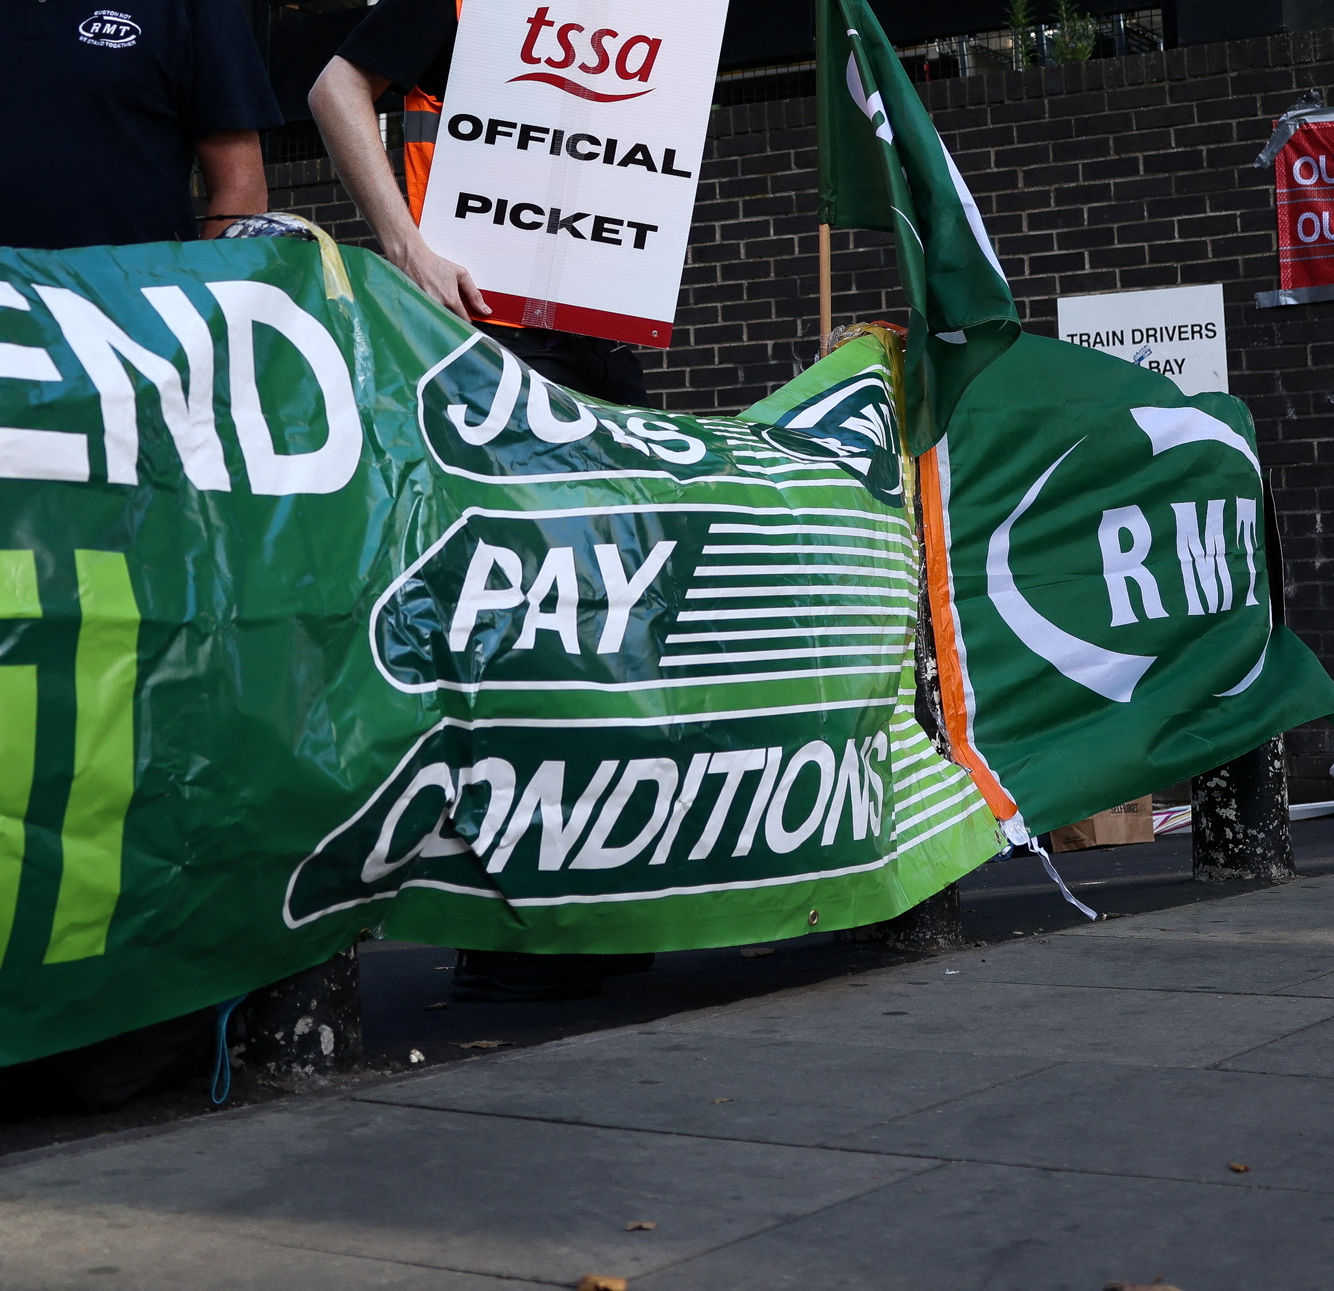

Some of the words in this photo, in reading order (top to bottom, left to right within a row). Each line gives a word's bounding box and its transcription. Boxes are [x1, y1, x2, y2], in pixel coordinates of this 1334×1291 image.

[90, 23, 130, 36] RMT
[519, 6, 662, 83] tssa
[447, 113, 692, 178] OFFICIAL
[455, 192, 659, 250] PICKET
[1067, 329, 1125, 348] TRAIN
[1131, 322, 1217, 345] DRIVERS
[1149, 358, 1186, 375] BAY
[1098, 497, 1258, 628] RMT
[450, 539, 678, 656] PAY
[361, 729, 889, 883] CONDITIONS
